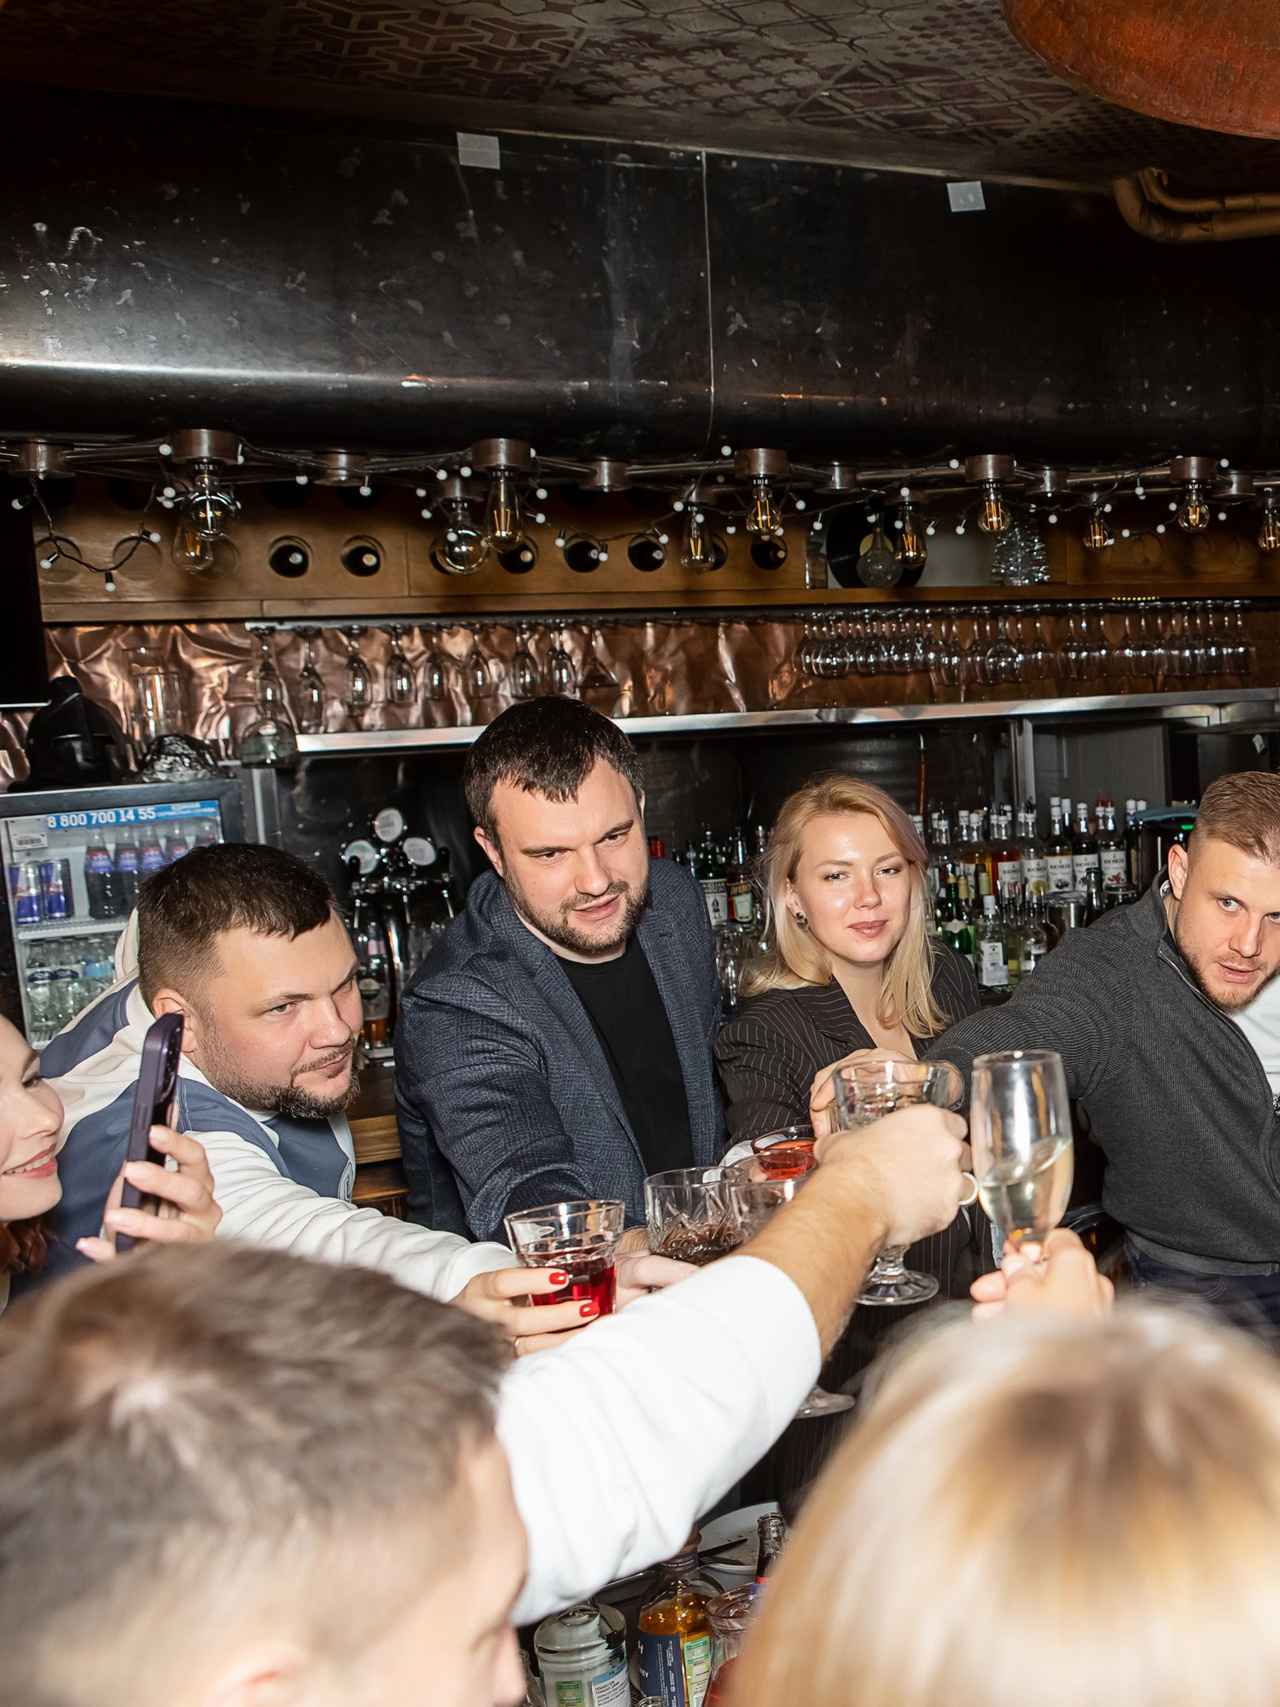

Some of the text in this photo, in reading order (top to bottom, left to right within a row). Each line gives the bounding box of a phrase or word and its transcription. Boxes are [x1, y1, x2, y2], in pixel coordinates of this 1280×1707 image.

[47, 807, 156, 828] 8 800 700 14 55
